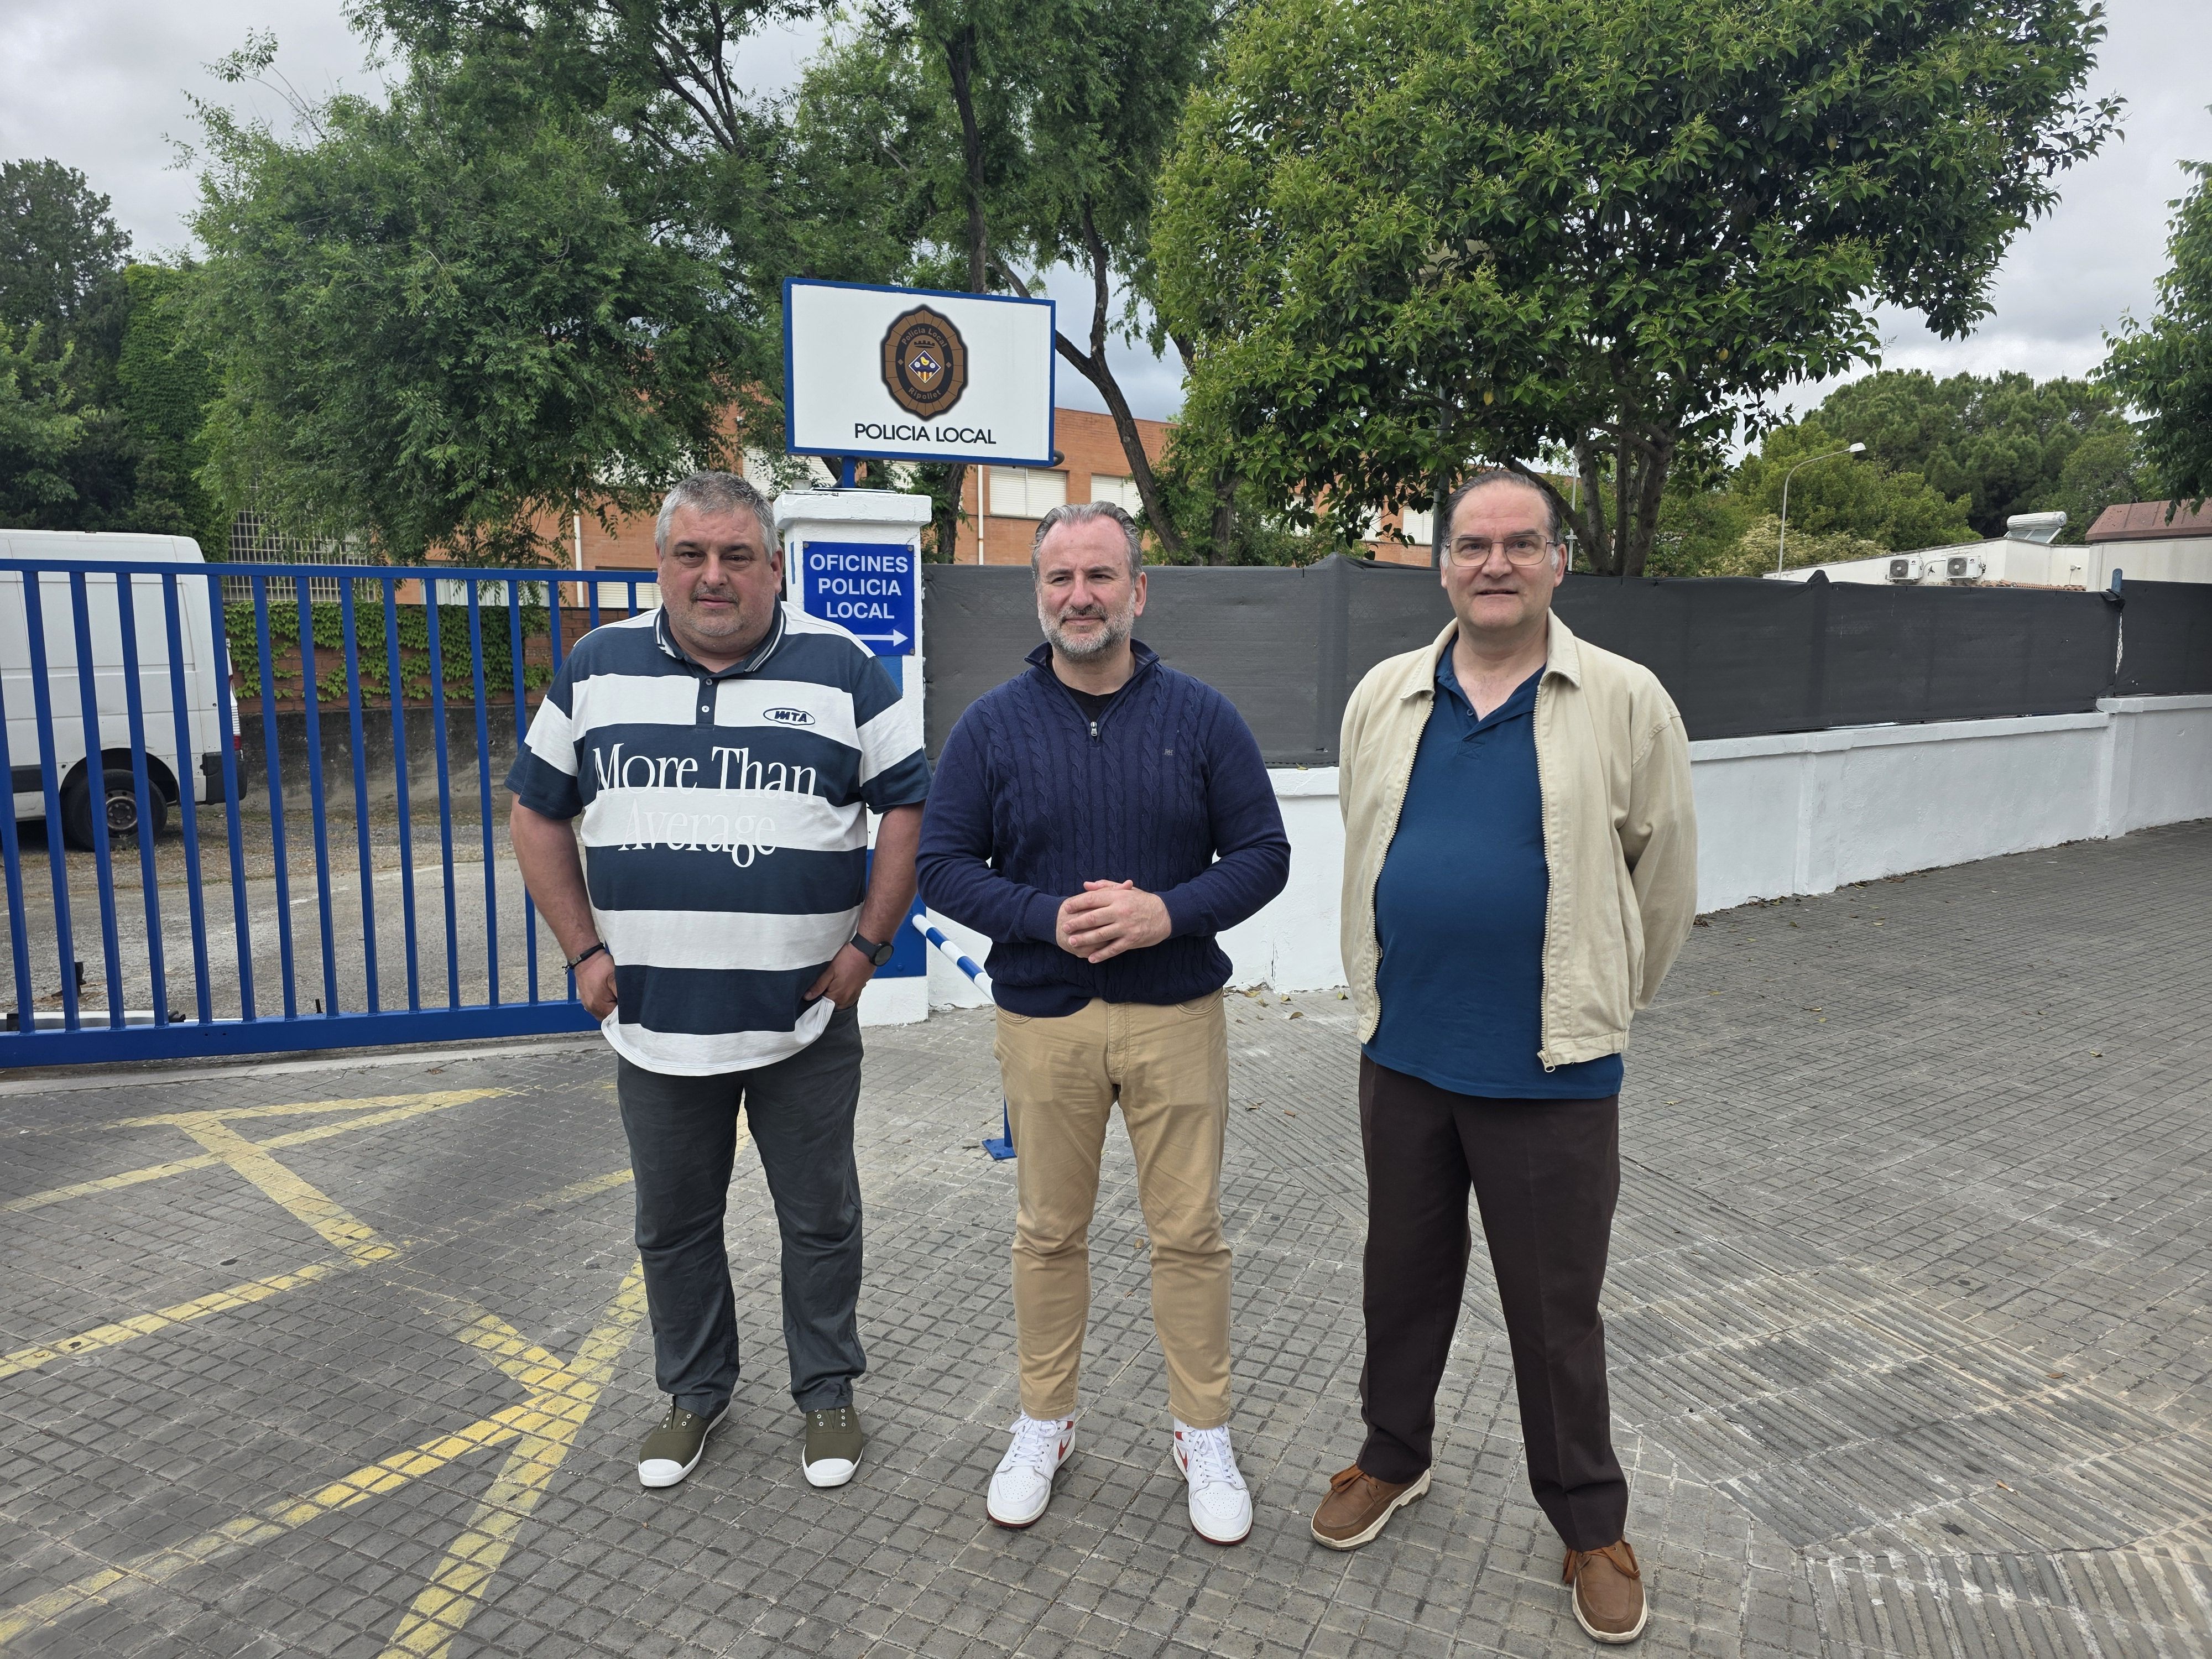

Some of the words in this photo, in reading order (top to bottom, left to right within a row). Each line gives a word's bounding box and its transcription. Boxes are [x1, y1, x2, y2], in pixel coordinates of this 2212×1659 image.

[901, 327, 926, 345] Policia
[928, 328, 947, 347] Local
[908, 388, 941, 399] Ripollet
[855, 423, 930, 441] POLICIA
[936, 427, 997, 445] LOCAL
[810, 554, 908, 573] OFICINES
[818, 578, 901, 596] POLICIA
[826, 602, 895, 619] LOCAL
[593, 743, 698, 795] More
[711, 746, 817, 805] Than
[618, 798, 776, 867] Average
